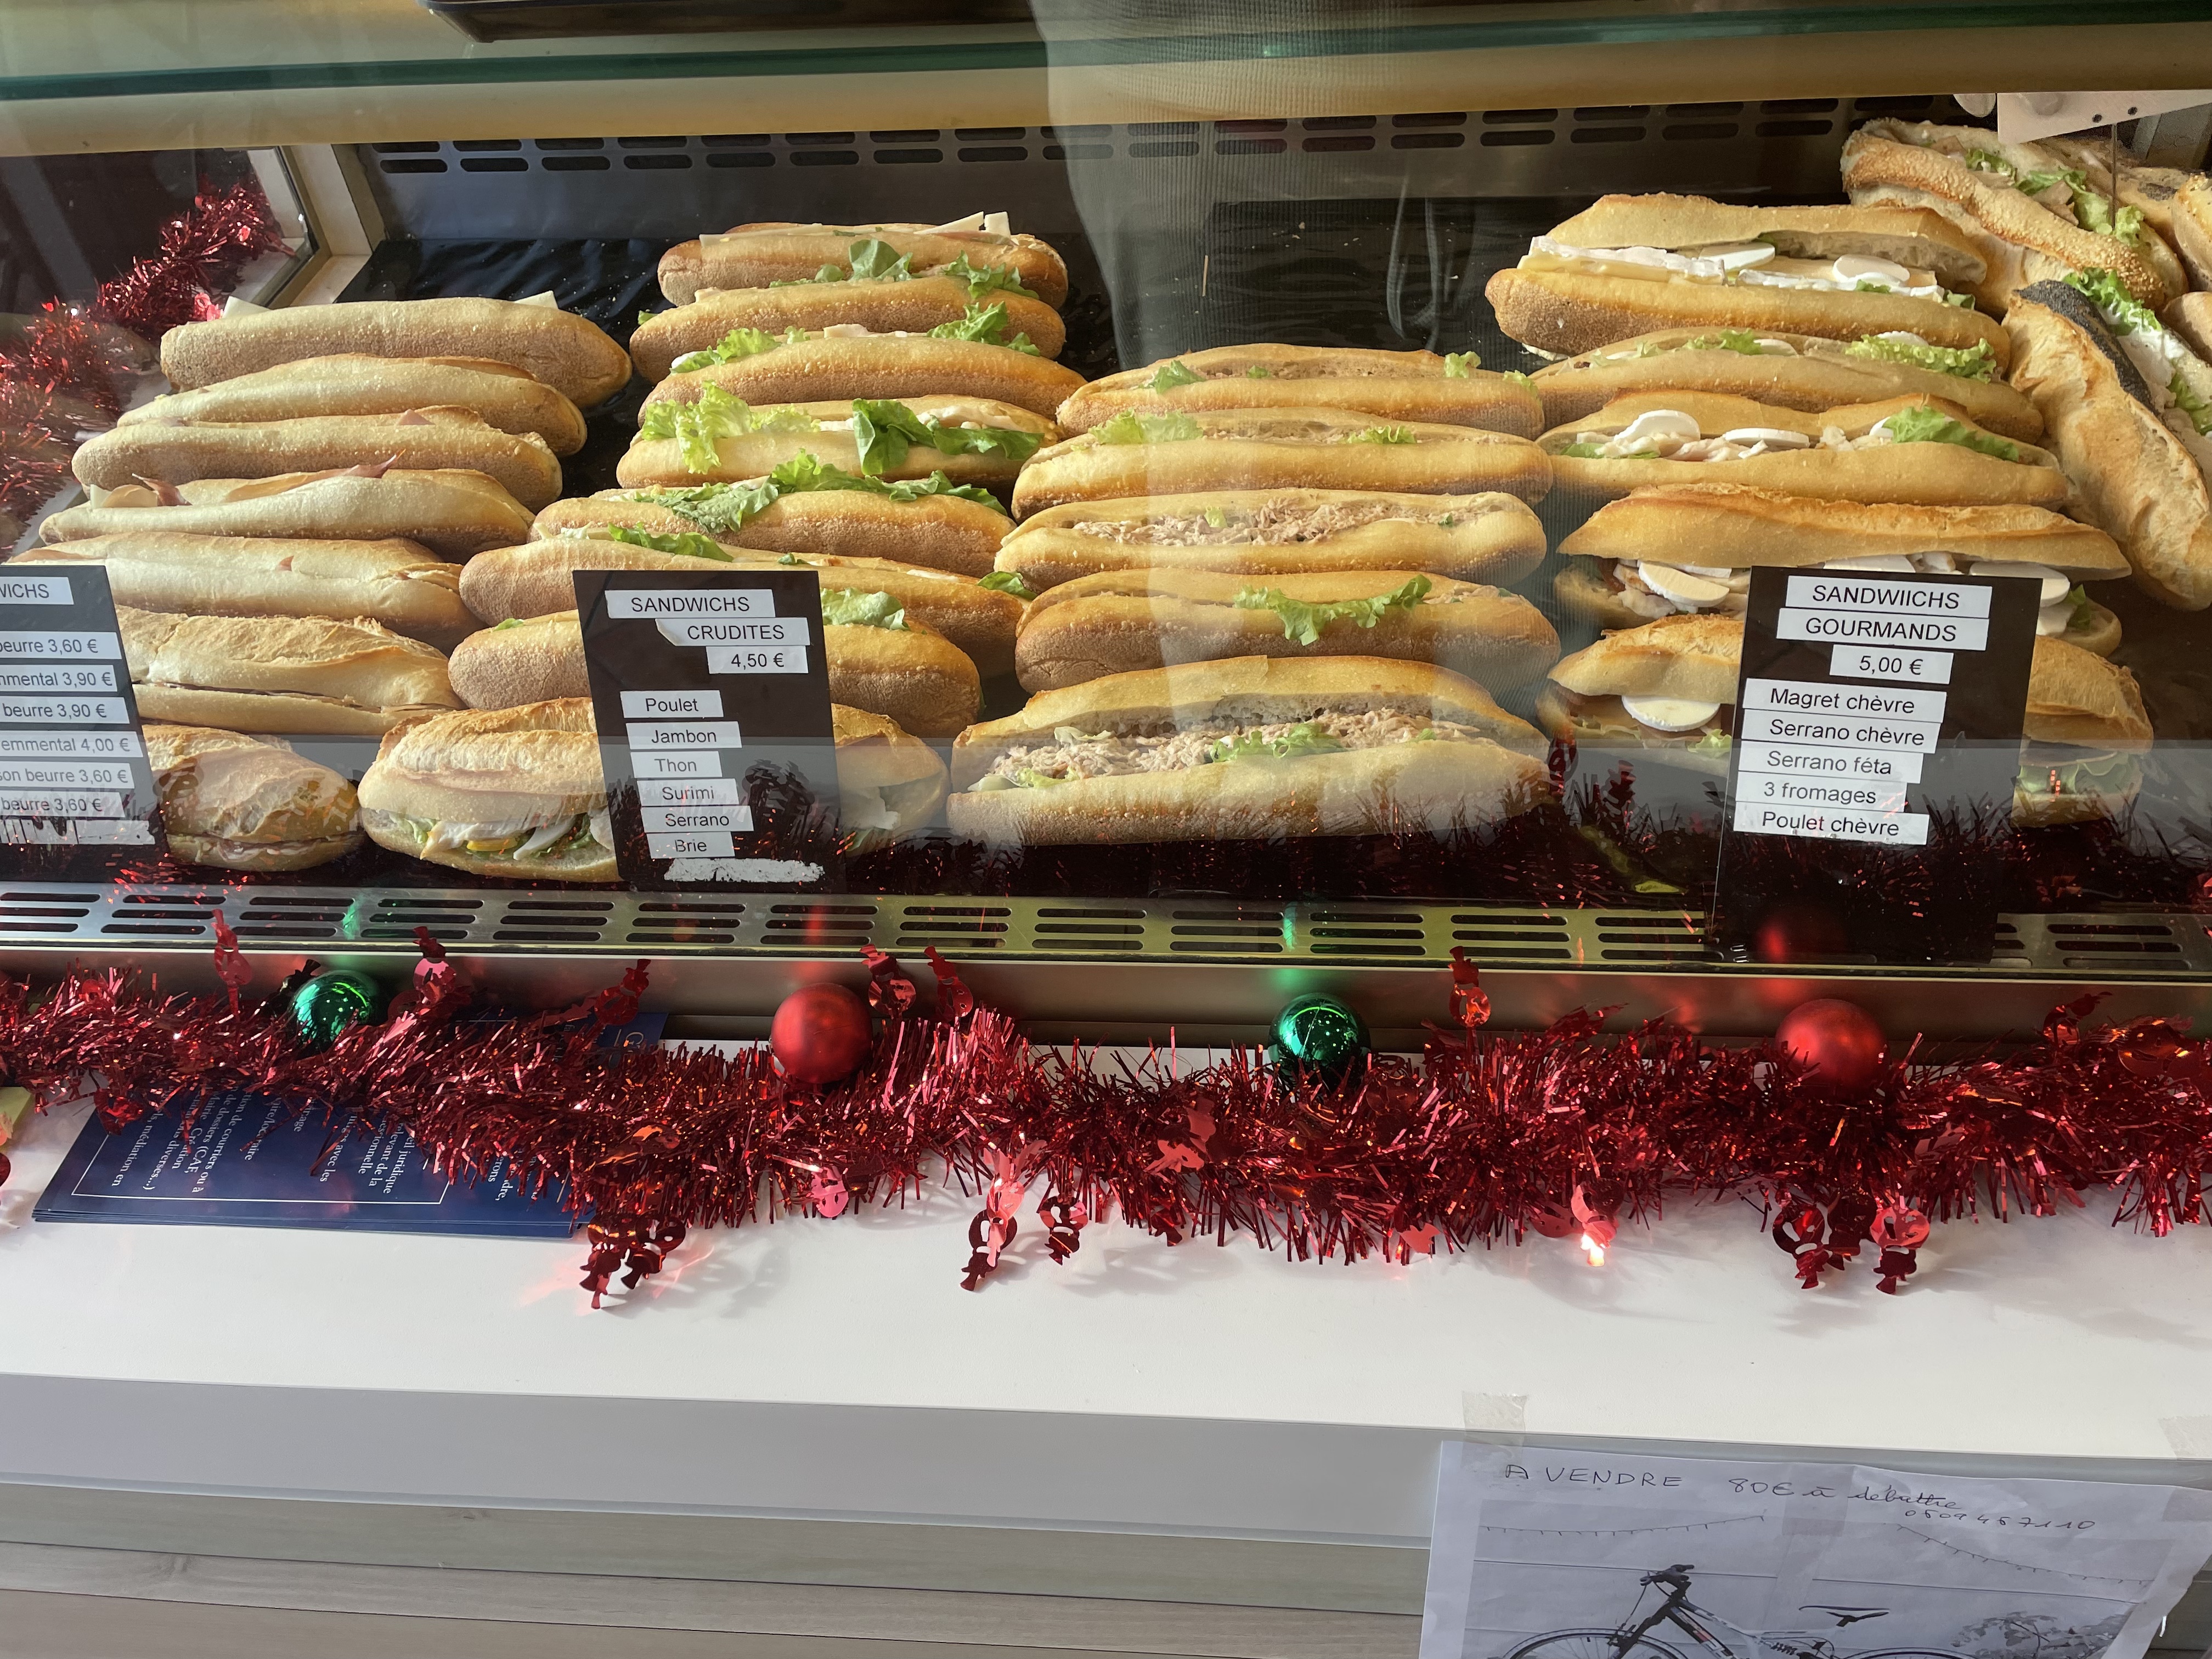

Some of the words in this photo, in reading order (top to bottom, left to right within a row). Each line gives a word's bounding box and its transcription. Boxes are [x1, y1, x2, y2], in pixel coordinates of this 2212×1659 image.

[631, 597, 750, 612] SANDWICHS
[1812, 585, 1960, 610] SANDWIICHS
[687, 625, 785, 640] CRUDITES
[1805, 617, 1957, 642] GOURMANDS
[0, 641, 43, 652] eurre
[48, 639, 82, 655] 3,60
[87, 639, 99, 653] €
[731, 653, 768, 670] 4,50
[773, 653, 785, 667] €
[1859, 655, 1903, 675] 5,00
[1909, 658, 1923, 675] €
[62, 672, 97, 688] 3,90
[101, 672, 112, 686] €
[645, 698, 699, 712] Poulet
[1770, 688, 1840, 708] Magret
[1846, 694, 1915, 714] chèvre
[2, 703, 53, 717] beurre
[57, 704, 91, 720] 3,90
[95, 703, 107, 718] €
[651, 729, 717, 744] Jambon
[1770, 719, 1850, 740] Serrano
[1856, 726, 1925, 746] chèvre
[1, 738, 76, 752] emmental
[81, 738, 114, 754] 4,00
[119, 737, 131, 752] €
[654, 758, 697, 772] Thon
[1767, 750, 1847, 771] Serrano
[1854, 757, 1892, 775] féta
[25, 768, 75, 782] beurre
[78, 769, 112, 785] 3,60
[117, 769, 128, 783] €
[662, 786, 714, 800] Surimi
[1763, 781, 1775, 797] 3
[1782, 782, 1876, 805] fromages
[1, 797, 50, 811] beurre
[54, 798, 87, 814] 3,60
[91, 798, 103, 812] €
[665, 813, 730, 827] Serrano
[1762, 811, 1824, 831] Poulet
[1831, 817, 1899, 836] chèvre
[674, 839, 707, 853] Brie
[202, 1107, 229, 1143] dossiers
[120, 1125, 153, 1172] médiation
[205, 1127, 233, 1170] courriers
[327, 1144, 344, 1167] avec
[111, 1173, 124, 1187] en
[196, 1172, 210, 1184] ou
[319, 1169, 336, 1183] les
[383, 1149, 411, 1194] juridique
[1505, 1464, 1529, 1480] A
[1545, 1466, 1683, 1487] VENDRE
